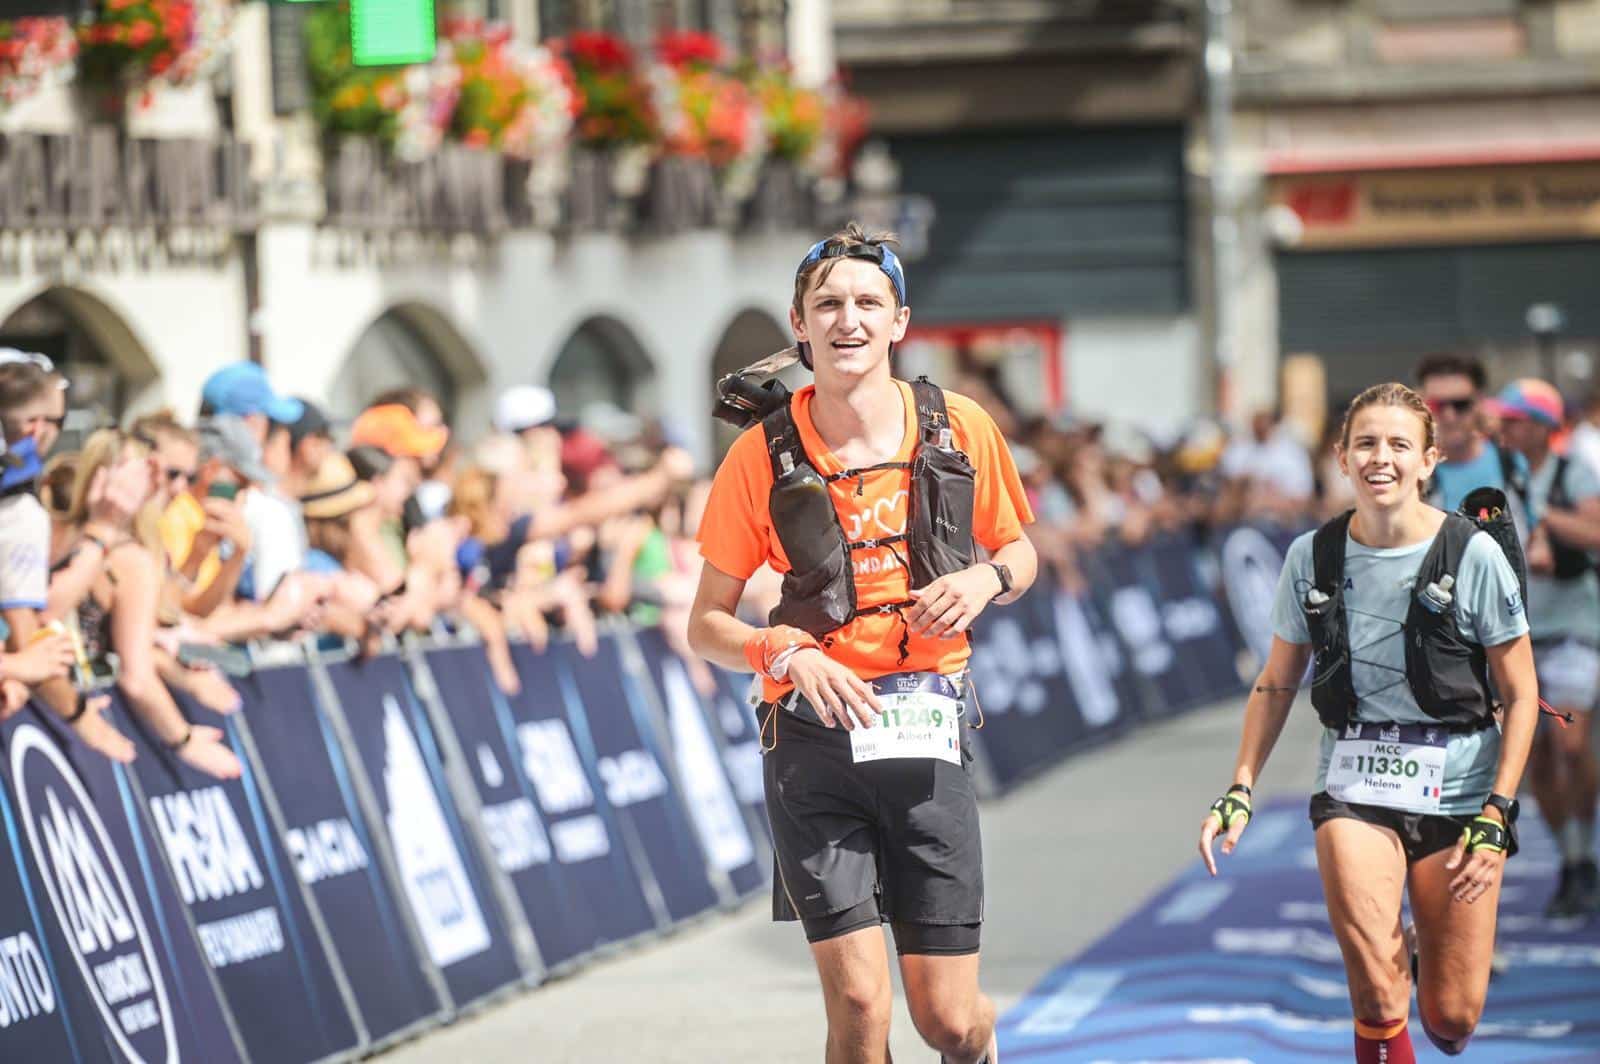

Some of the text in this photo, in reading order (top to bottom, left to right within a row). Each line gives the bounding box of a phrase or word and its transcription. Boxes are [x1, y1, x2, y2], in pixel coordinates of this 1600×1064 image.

[881, 708, 944, 729] 11249
[897, 731, 933, 741] Albert
[1374, 745, 1401, 755] MCC
[1356, 755, 1420, 778] 11330
[1364, 777, 1402, 790] Helene
[0, 930, 56, 1029] NTO
